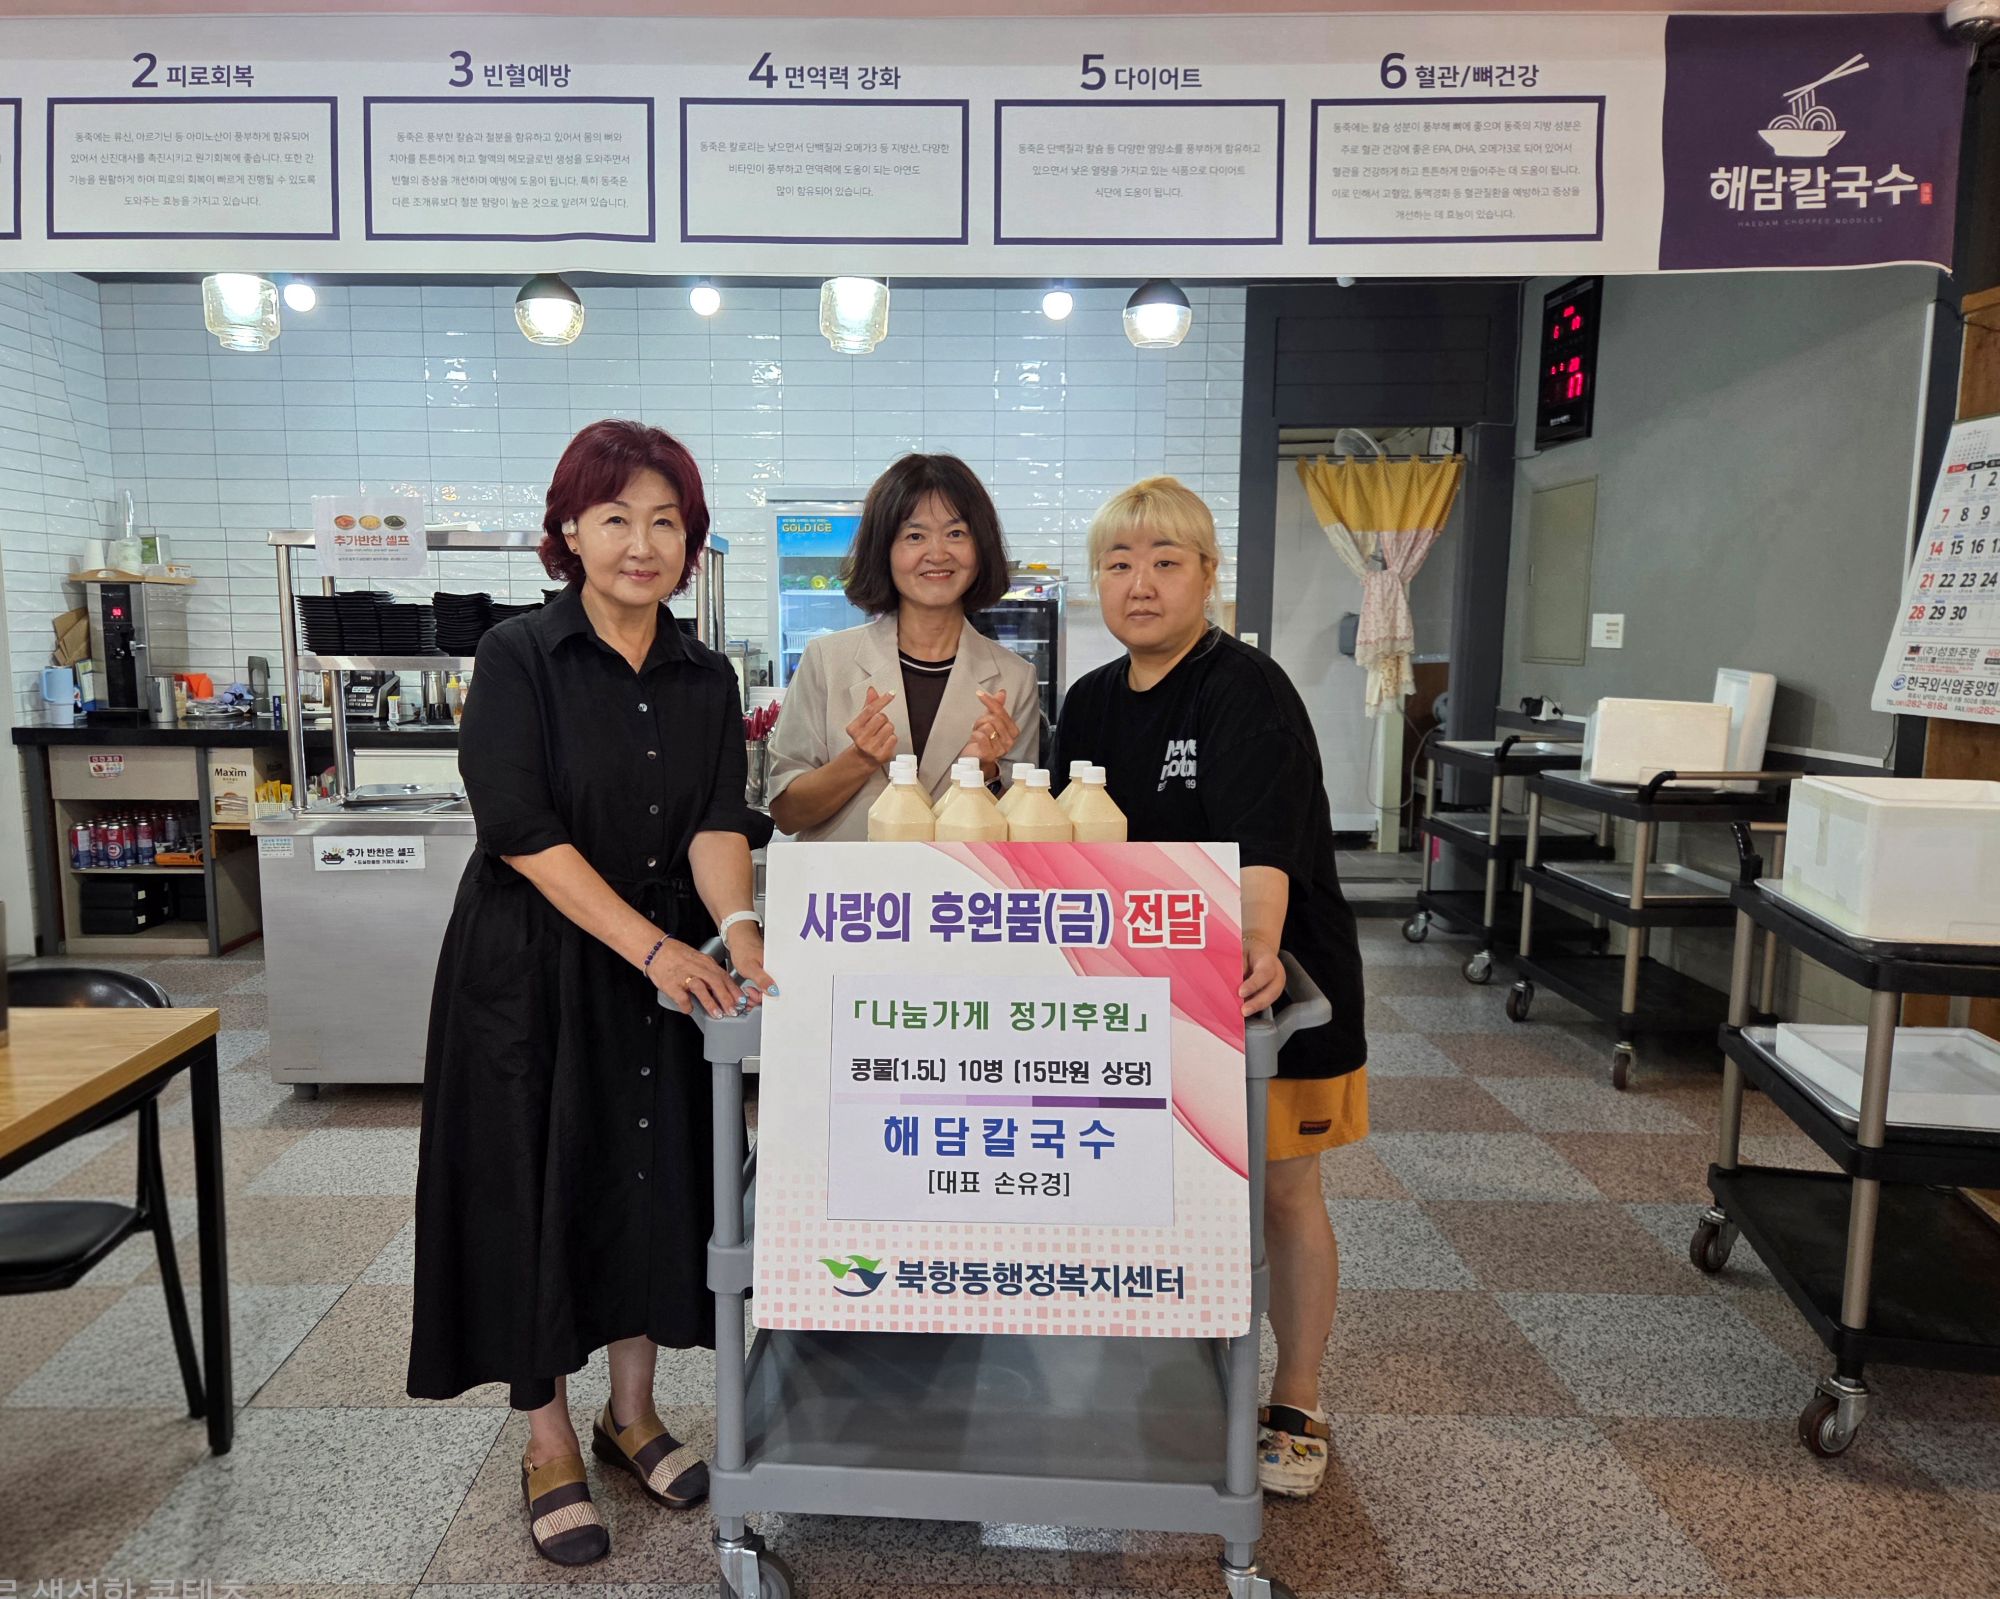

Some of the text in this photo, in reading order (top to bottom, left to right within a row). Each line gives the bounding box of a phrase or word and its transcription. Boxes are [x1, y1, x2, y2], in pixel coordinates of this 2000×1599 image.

[132, 53, 255, 88] 2 피로회복
[449, 50, 572, 88] 3 빈혈예방
[748, 52, 901, 90] 4 면역력 강화
[1080, 54, 1203, 90] 5 다이어트
[1380, 52, 1540, 89] 6 혈관/뼈건강
[1710, 164, 1918, 211] 해담칼국수
[1970, 471, 1998, 488] 1 2
[1941, 505, 1991, 523] 7 8 9
[334, 535, 410, 546] 추가반찬 셀프
[782, 523, 832, 533] GOLD ICE
[1930, 541, 1944, 556] 14
[1950, 540, 1964, 556] 15
[1971, 538, 1985, 554] 16
[1920, 571, 1998, 589] 21 22 23 24
[1908, 605, 1967, 620] 28 29 30
[214, 767, 247, 777] Maxim
[346, 848, 364, 857] 추가
[366, 848, 394, 857] 반찬은
[800, 891, 1204, 945] 사랑의 후원품(금) 전달
[853, 1000, 1148, 1033] 「나눔가게 정기후원」
[958, 1058, 1004, 1084] 10병
[928, 1169, 1070, 1197] [대표 손유경]
[895, 1260, 1185, 1300] 북항동행정복지센터
